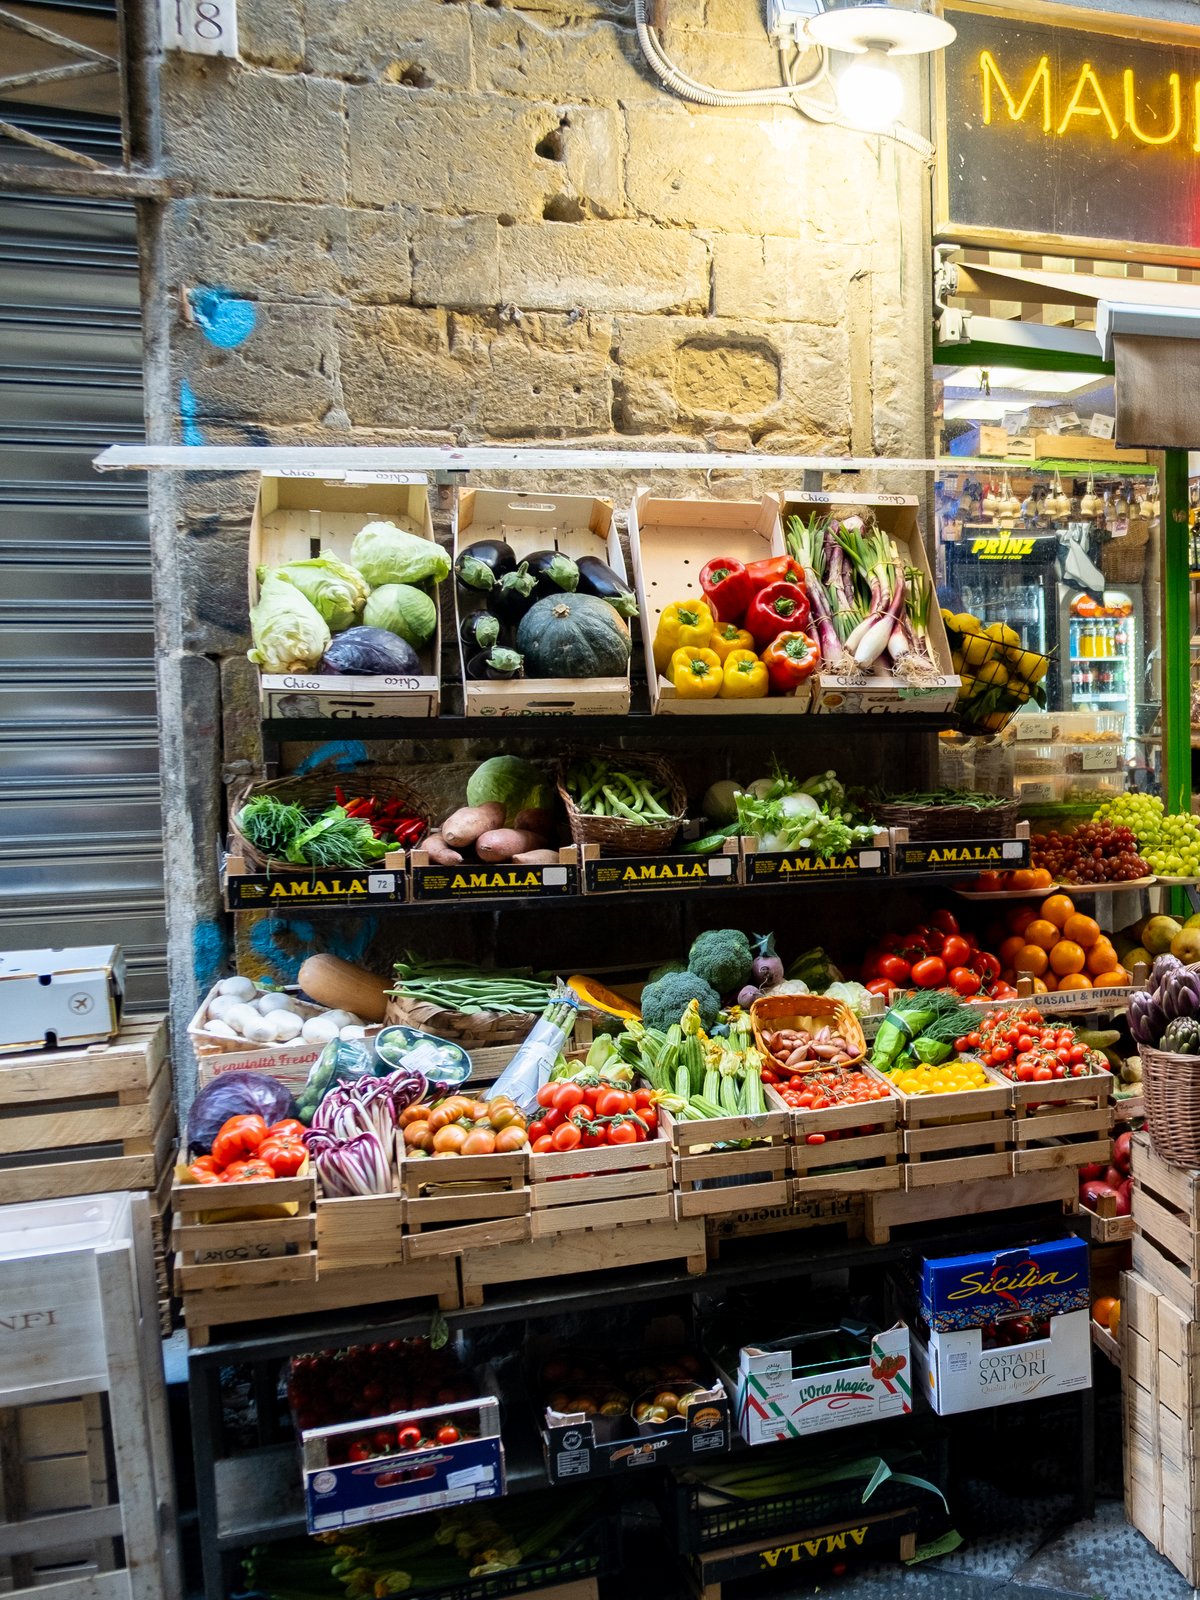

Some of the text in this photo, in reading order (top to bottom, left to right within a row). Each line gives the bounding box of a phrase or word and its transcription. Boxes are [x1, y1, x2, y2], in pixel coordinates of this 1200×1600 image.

[801, 493, 830, 503] Chico
[971, 532, 1036, 554] PRINZ
[283, 676, 420, 690] Chico Chico
[377, 880, 388, 889] 72
[1034, 993, 1076, 1006] CASALI
[1080, 991, 1088, 1000] &
[947, 1266, 1079, 1300] Sicilia
[979, 1359, 1046, 1386] SAPORI
[799, 1384, 832, 1404] L'Orto
[833, 1377, 875, 1394] Magico
